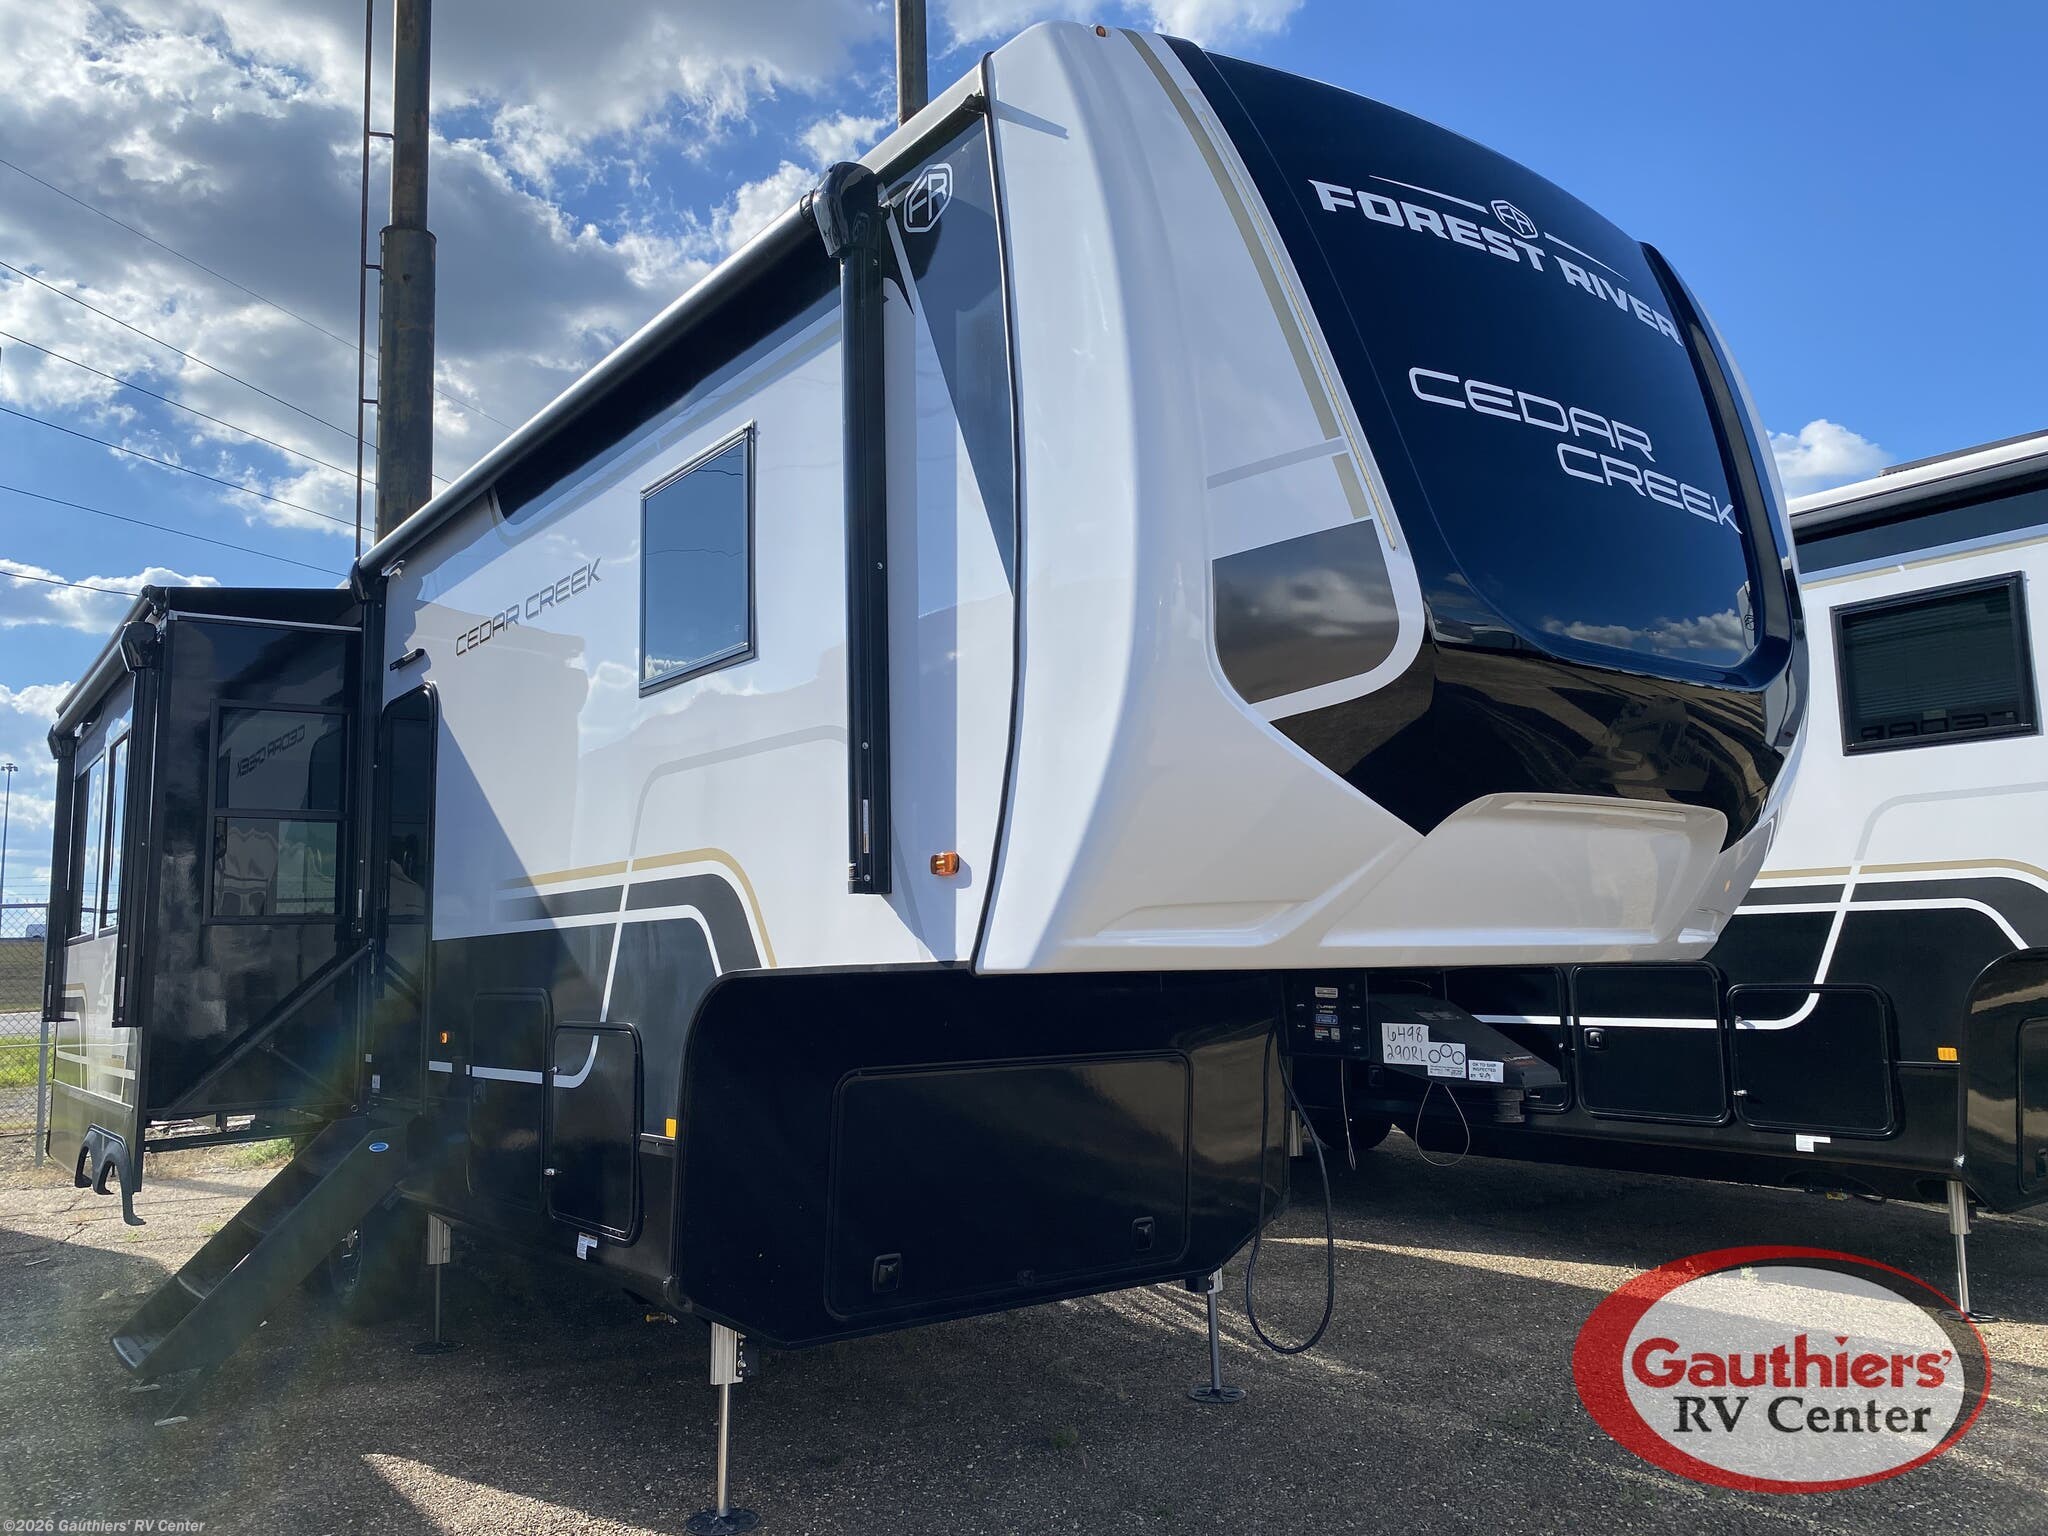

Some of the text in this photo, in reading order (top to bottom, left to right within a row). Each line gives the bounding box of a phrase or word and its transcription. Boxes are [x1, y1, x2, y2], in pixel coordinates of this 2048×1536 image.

[1308, 180, 1684, 347] FOREST RIVER
[1408, 367, 1656, 462] CEDAR
[1556, 443, 1743, 535] CREEK
[455, 556, 602, 656] CEDAR CREEK
[1386, 1025, 1423, 1043] 6498
[1386, 1044, 1426, 1062] 290RL
